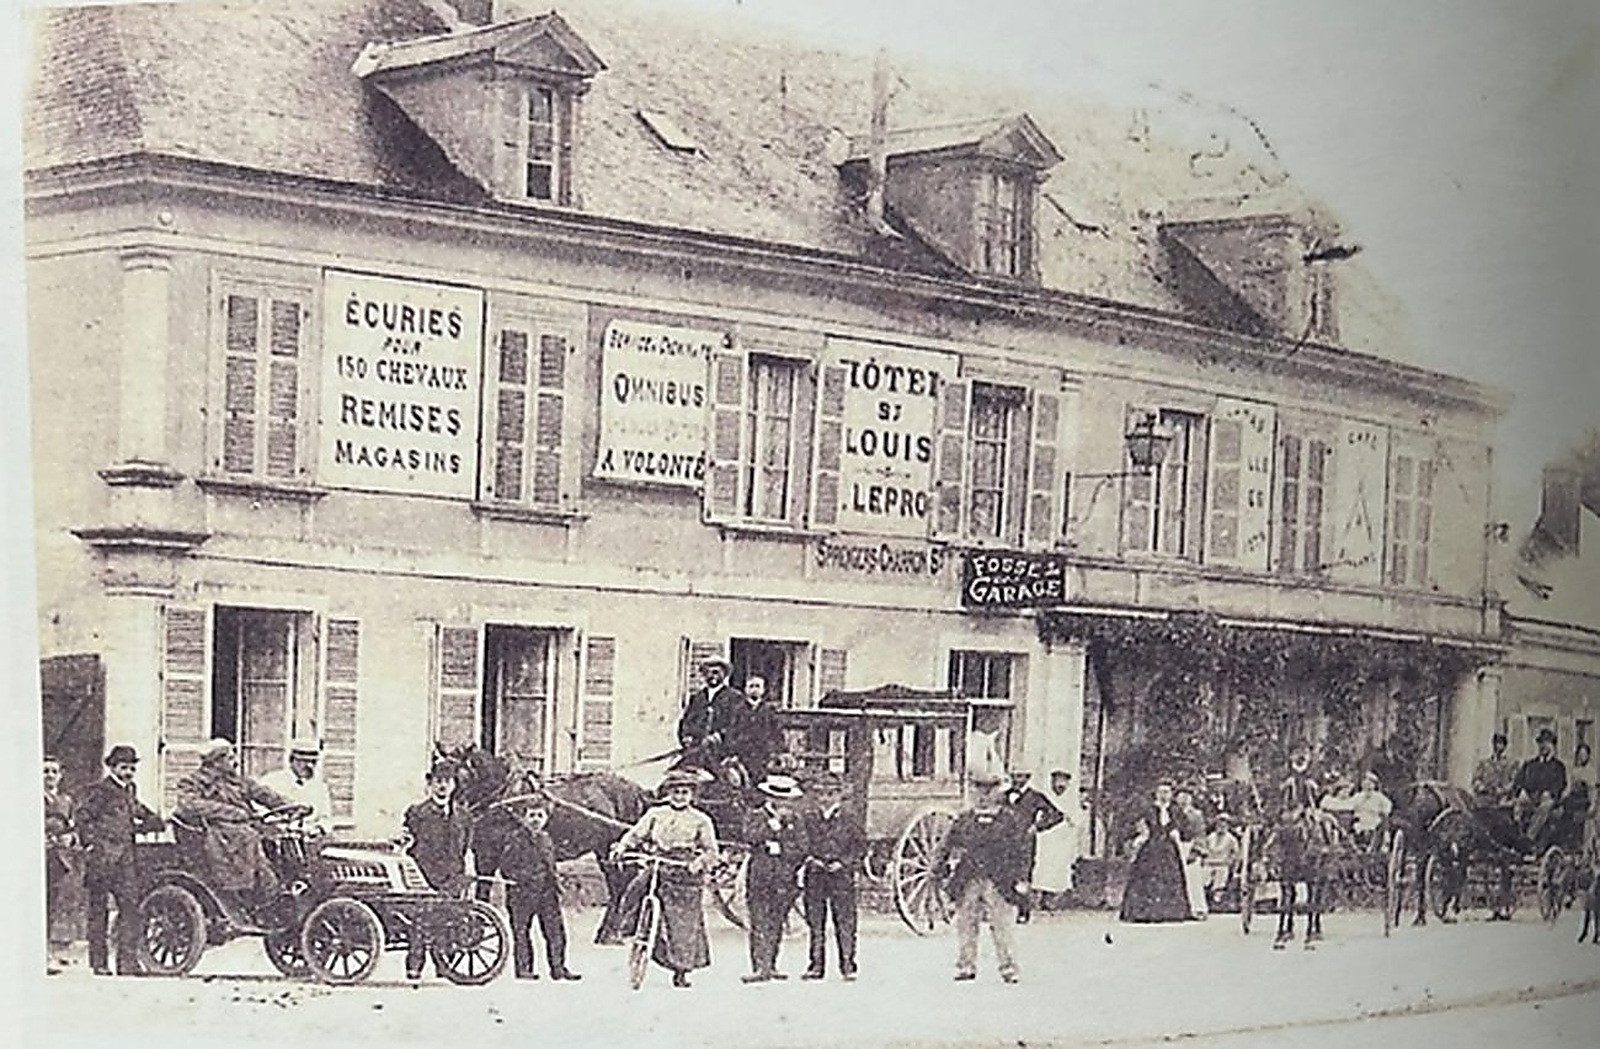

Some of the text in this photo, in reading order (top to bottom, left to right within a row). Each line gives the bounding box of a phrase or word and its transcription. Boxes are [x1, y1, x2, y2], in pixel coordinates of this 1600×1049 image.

[337, 354, 467, 390] 150 CHEVAUX
[614, 373, 704, 407] OMNIBUS
[341, 393, 461, 436] REMISES
[335, 439, 462, 474] MAGASINS
[846, 428, 932, 462] LOUIS
[969, 576, 1061, 603] GARAGE
